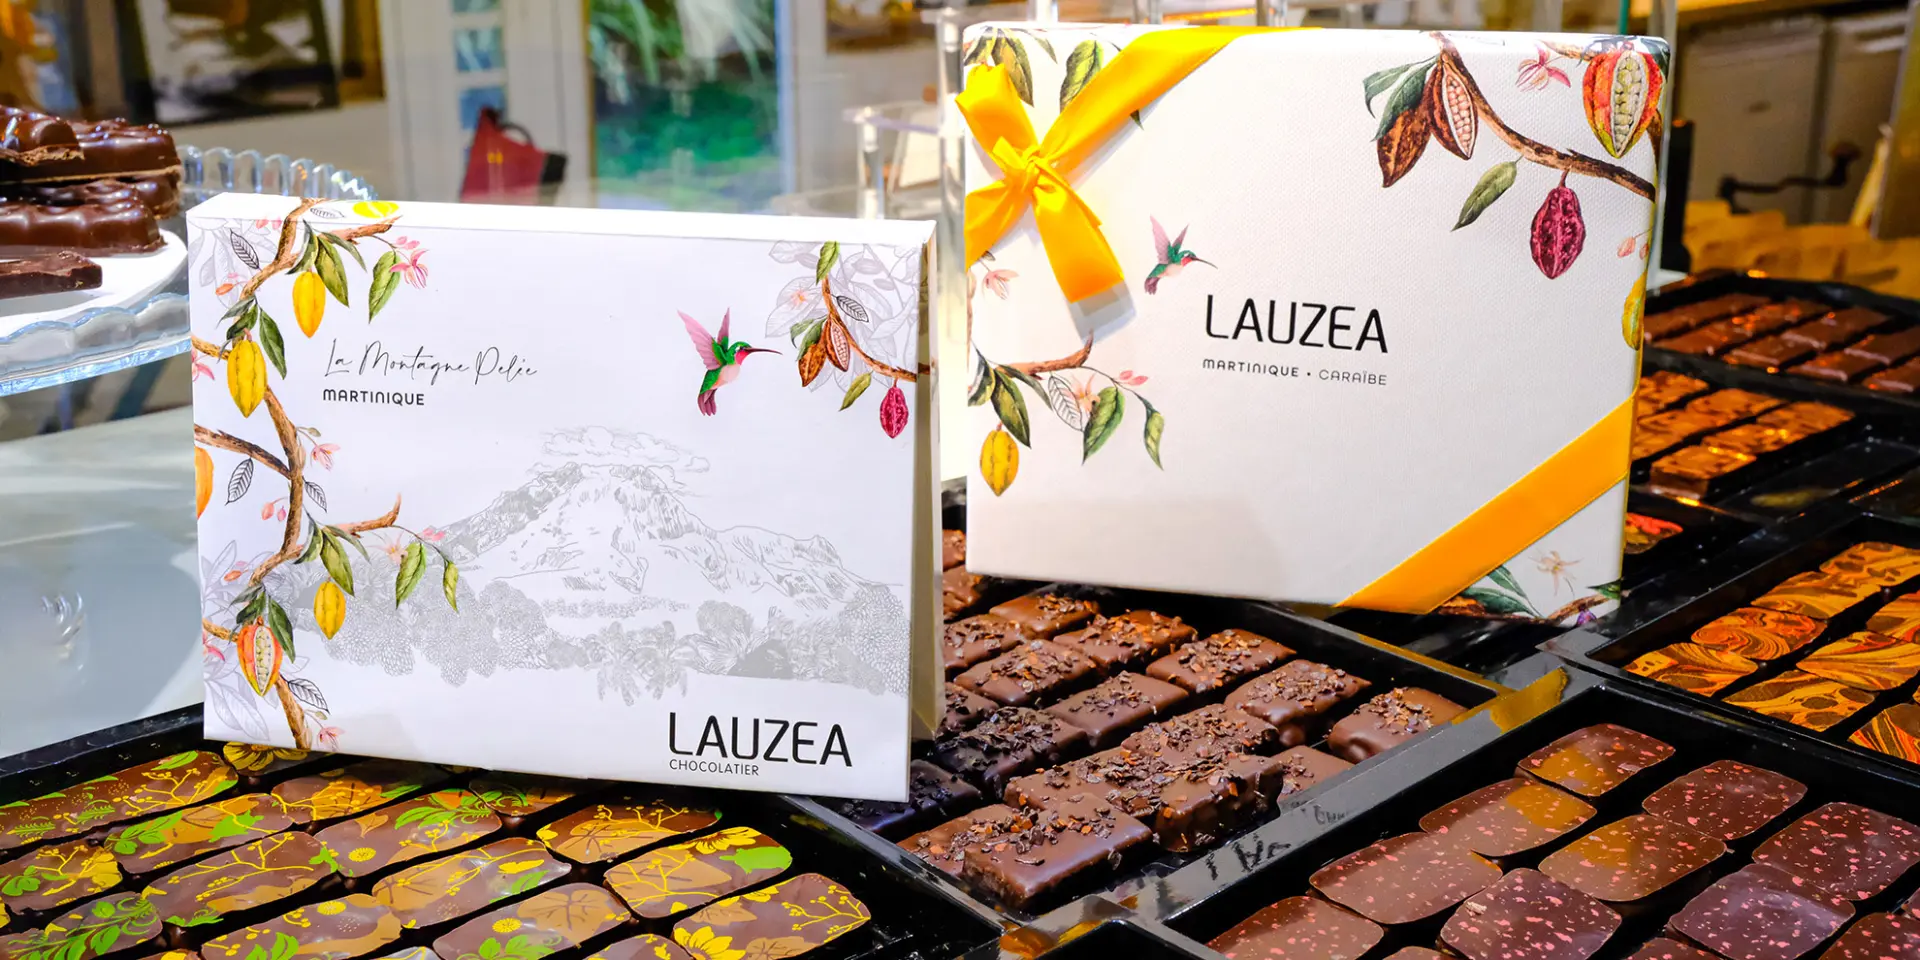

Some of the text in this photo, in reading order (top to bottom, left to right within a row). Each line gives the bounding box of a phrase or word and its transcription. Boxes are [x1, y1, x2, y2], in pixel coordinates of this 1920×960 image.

[1205, 294, 1388, 353] LAUZEA
[324, 338, 538, 386] La Montagne Pelée
[1202, 358, 1388, 386] MARTINIQUE CARAÏBE
[322, 388, 425, 406] MARTINIQUE
[668, 712, 852, 767] LAUZEA
[669, 758, 759, 775] CHOCOLATIER
